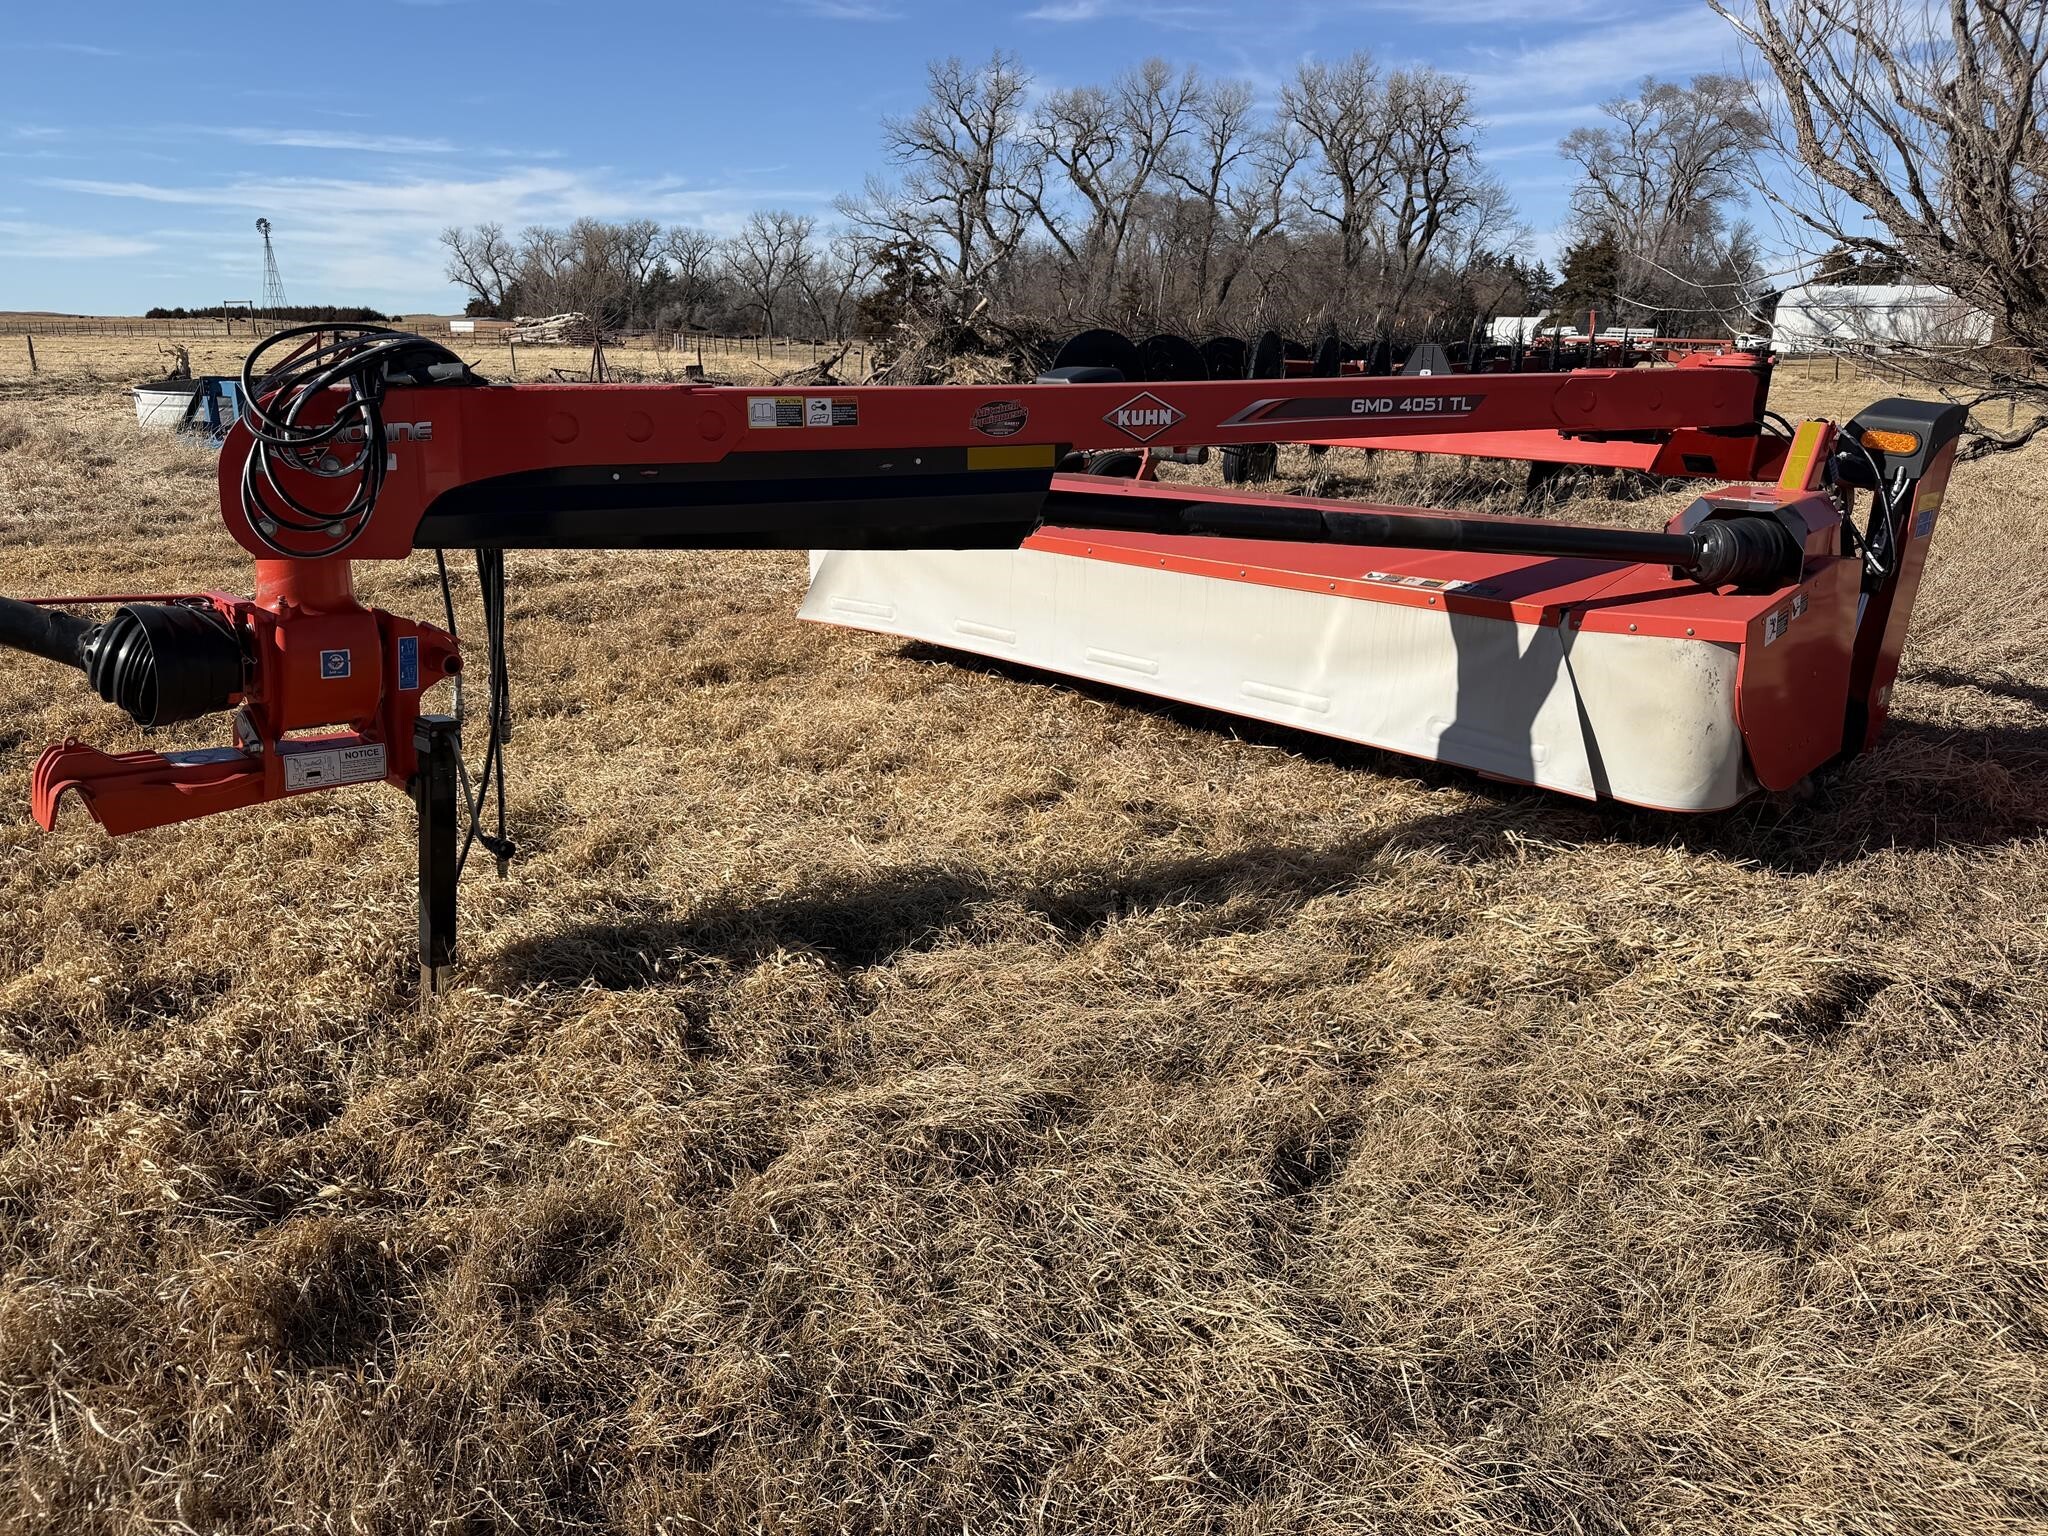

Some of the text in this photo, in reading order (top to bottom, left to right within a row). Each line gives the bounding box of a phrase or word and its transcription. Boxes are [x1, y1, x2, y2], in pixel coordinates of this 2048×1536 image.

[1351, 396, 1472, 413] GMD 4051 TL
[1117, 409, 1170, 426] KUHN
[344, 748, 380, 760] NOTICE
